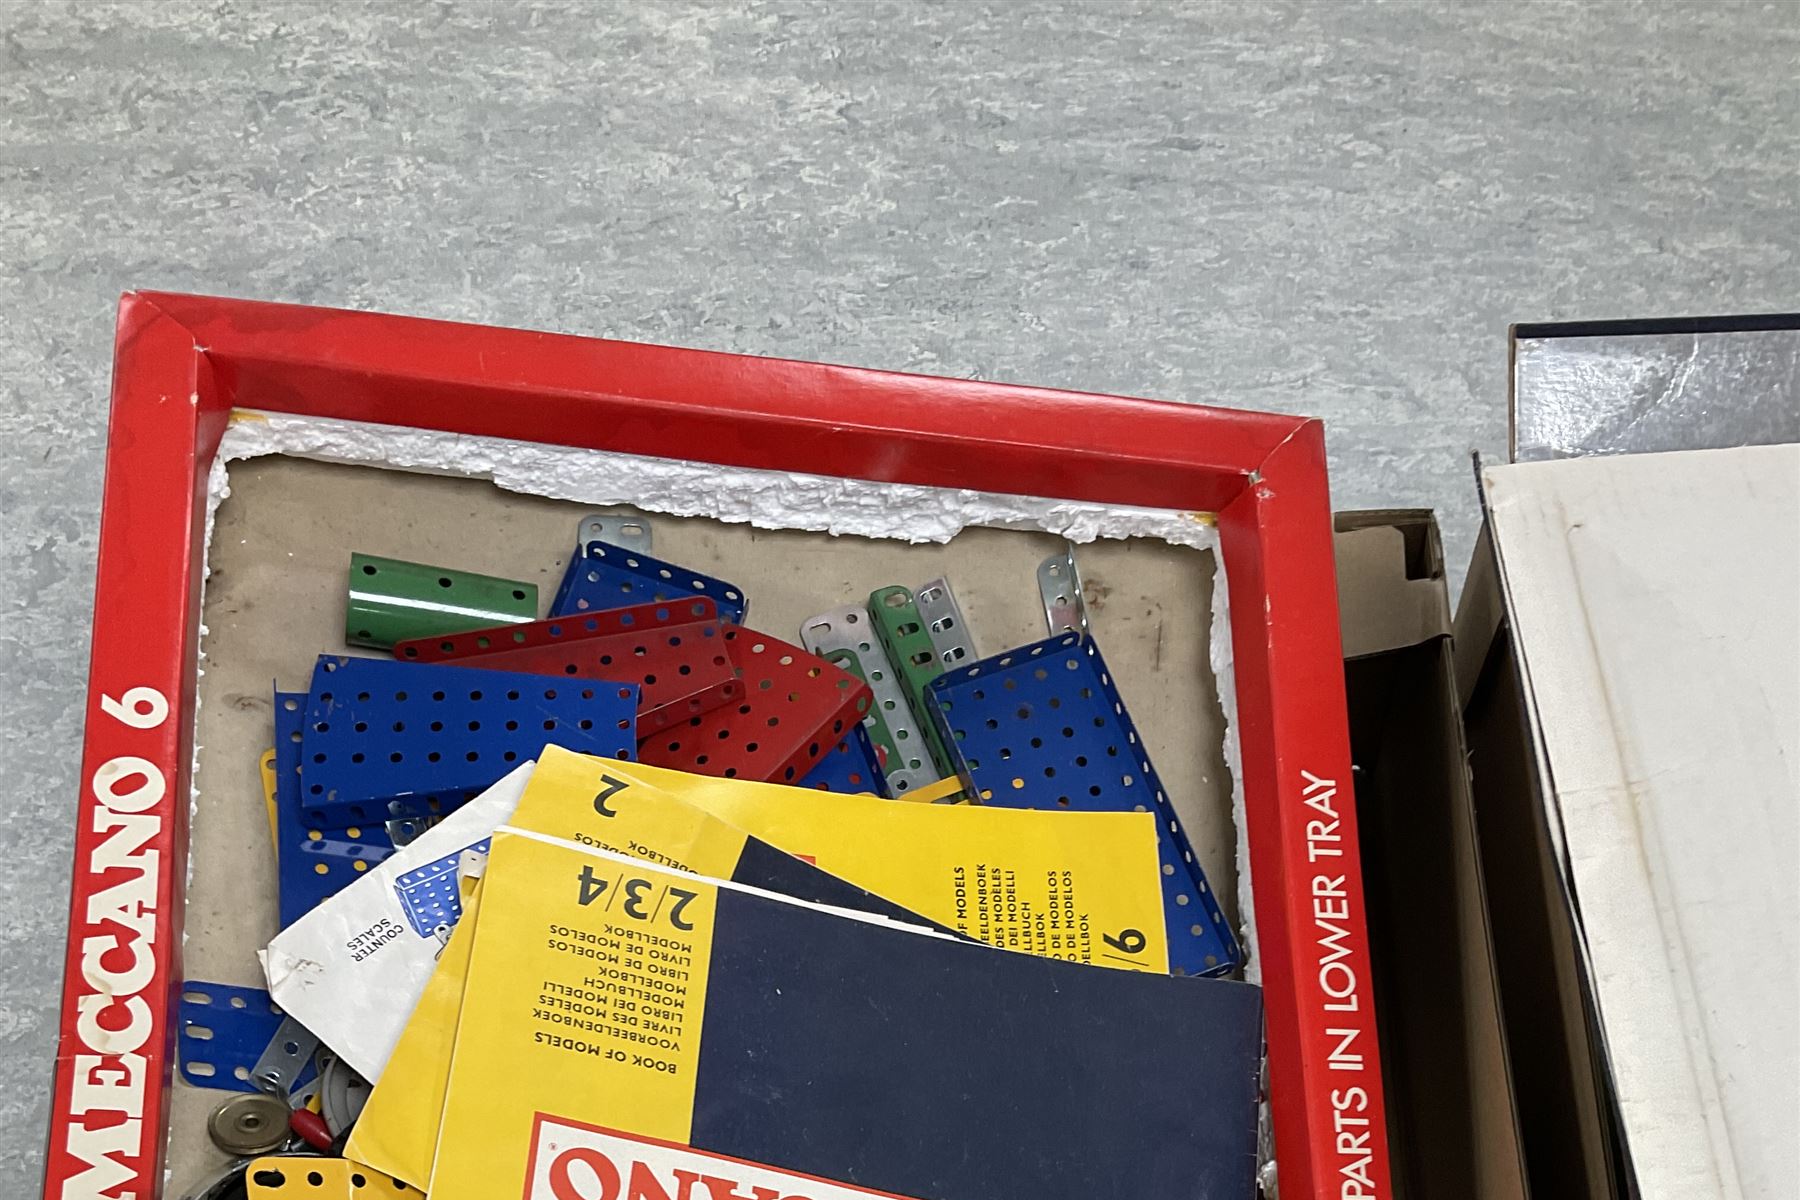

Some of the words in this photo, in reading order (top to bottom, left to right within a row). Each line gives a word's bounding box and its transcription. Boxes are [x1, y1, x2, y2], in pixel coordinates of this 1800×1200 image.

[101, 686, 169, 729] 6
[593, 774, 630, 818] 2
[1300, 769, 1343, 863] TRAY
[577, 865, 698, 931] 2/3/4
[954, 867, 967, 919] MODELS
[976, 864, 990, 944] EELDENBOEK
[1005, 870, 1018, 922] MODELLI
[1047, 870, 1060, 929] MODELOS
[1062, 870, 1075, 929] MODELOS
[346, 918, 391, 951] SCALES
[351, 924, 404, 962] COUNTER
[549, 924, 621, 950] MODELOS
[604, 924, 692, 953] MODELLBOK
[995, 926, 1005, 948] DES
[1009, 927, 1019, 946] DEI
[1051, 934, 1061, 949] DE
[1067, 934, 1077, 949] DE
[1312, 874, 1359, 1011] LOWER
[548, 939, 619, 965] MODELOS
[626, 943, 644, 956] DE
[649, 950, 691, 967] LIVRO
[625, 957, 642, 970] DE
[647, 964, 689, 981] LIBRO
[543, 981, 608, 1005] MODELLI
[584, 976, 685, 1010] MODELLBUCH
[598, 966, 687, 996] MODELLBOK
[613, 998, 636, 1012] DEI
[641, 1005, 684, 1023] LIBRO
[532, 1007, 681, 1052] VOORBEELDENBOEK
[612, 1012, 638, 1027] DES
[642, 1019, 682, 1037] LIVRE
[534, 1031, 600, 1057] MODELS
[605, 1048, 627, 1063] OF
[1324, 1028, 1364, 1071] IN
[632, 1054, 677, 1074] BOOK
